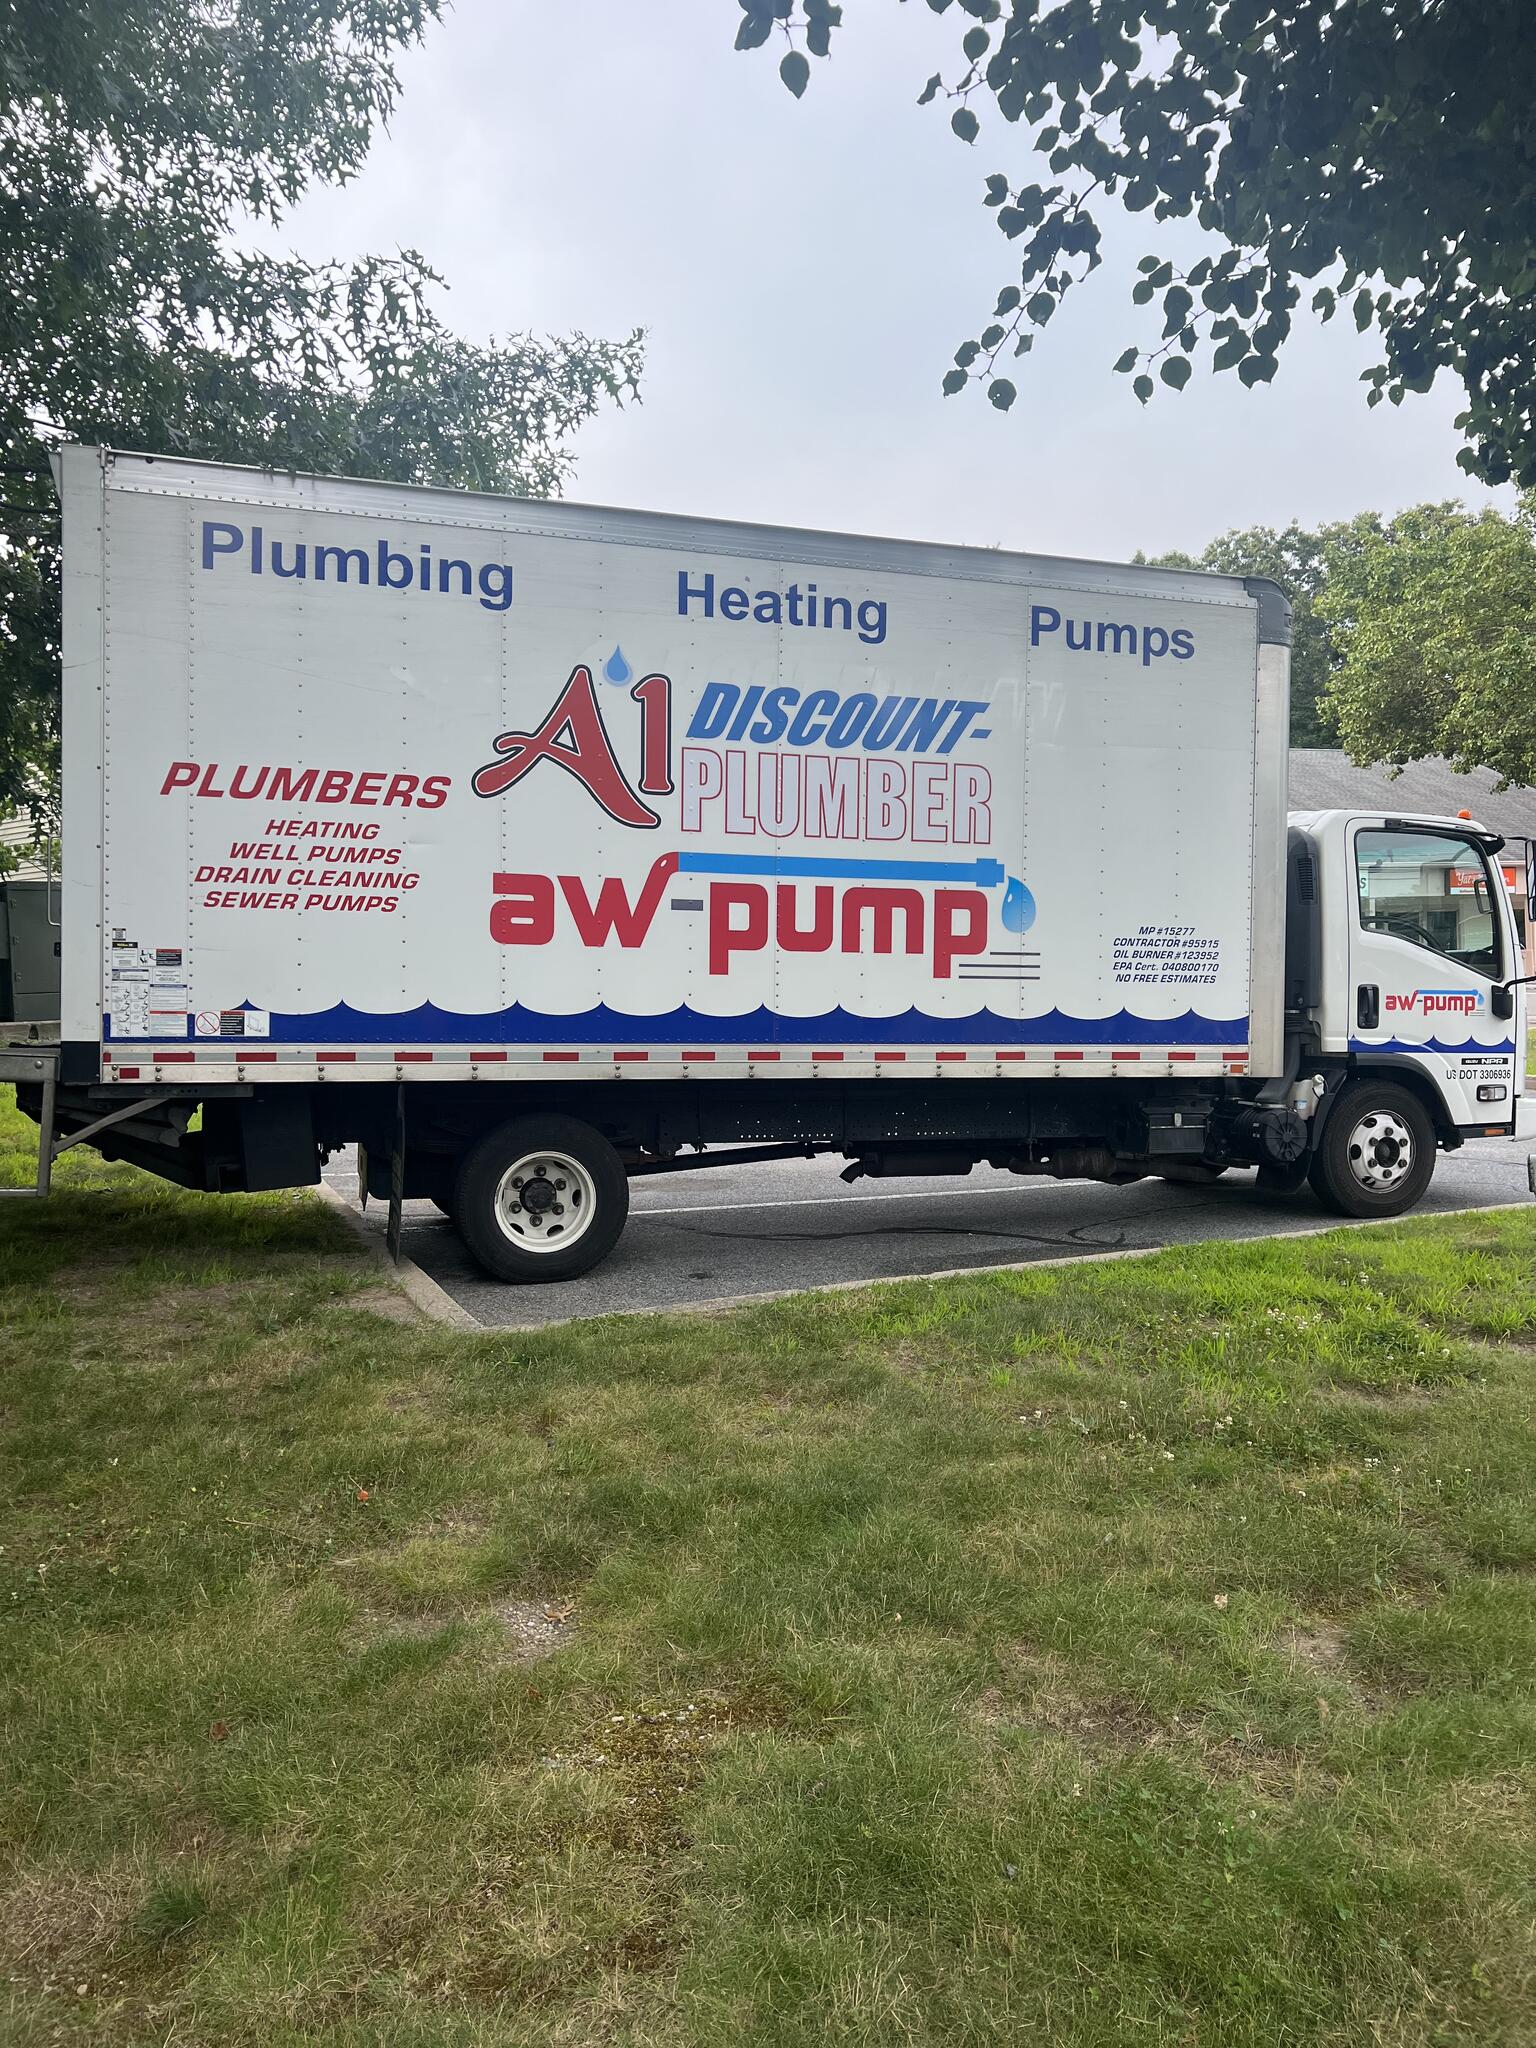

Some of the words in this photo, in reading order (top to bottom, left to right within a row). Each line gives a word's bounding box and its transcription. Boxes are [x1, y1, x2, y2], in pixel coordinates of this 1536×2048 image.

[203, 522, 513, 610] Plumbing
[678, 571, 887, 644] Heating
[1031, 606, 1195, 666] Pumps
[471, 664, 675, 829] A1
[160, 761, 452, 809] PLUMBERS
[681, 747, 992, 844] PLUMBER
[264, 819, 380, 840] HEATING
[229, 842, 300, 861] WELL
[307, 845, 401, 865] PUMPS
[194, 866, 281, 885] DRAIN
[287, 869, 420, 890] CLEANING
[203, 891, 298, 910] SEWER
[304, 894, 399, 913] PUMPS
[490, 851, 989, 979] aw-pump
[1139, 926, 1156, 935] MP
[1156, 927, 1196, 936] #15277
[1113, 937, 1181, 948] CONTRACTOR
[1181, 939, 1220, 949] #95915
[1113, 949, 1129, 959] OIL
[1131, 950, 1174, 960] BURNER
[1174, 951, 1219, 960] #123952
[1113, 961, 1132, 971] EPA
[1134, 962, 1159, 972] Cert.
[1161, 962, 1220, 972] 040800170
[1115, 973, 1131, 983] NO
[1132, 974, 1159, 983] FREE
[1160, 974, 1217, 984] ESTIMATES
[1385, 989, 1476, 1016] aw-pump
[1446, 1069, 1457, 1080] US
[1459, 1069, 1478, 1079] DOT
[1479, 1069, 1512, 1080] 3306936
